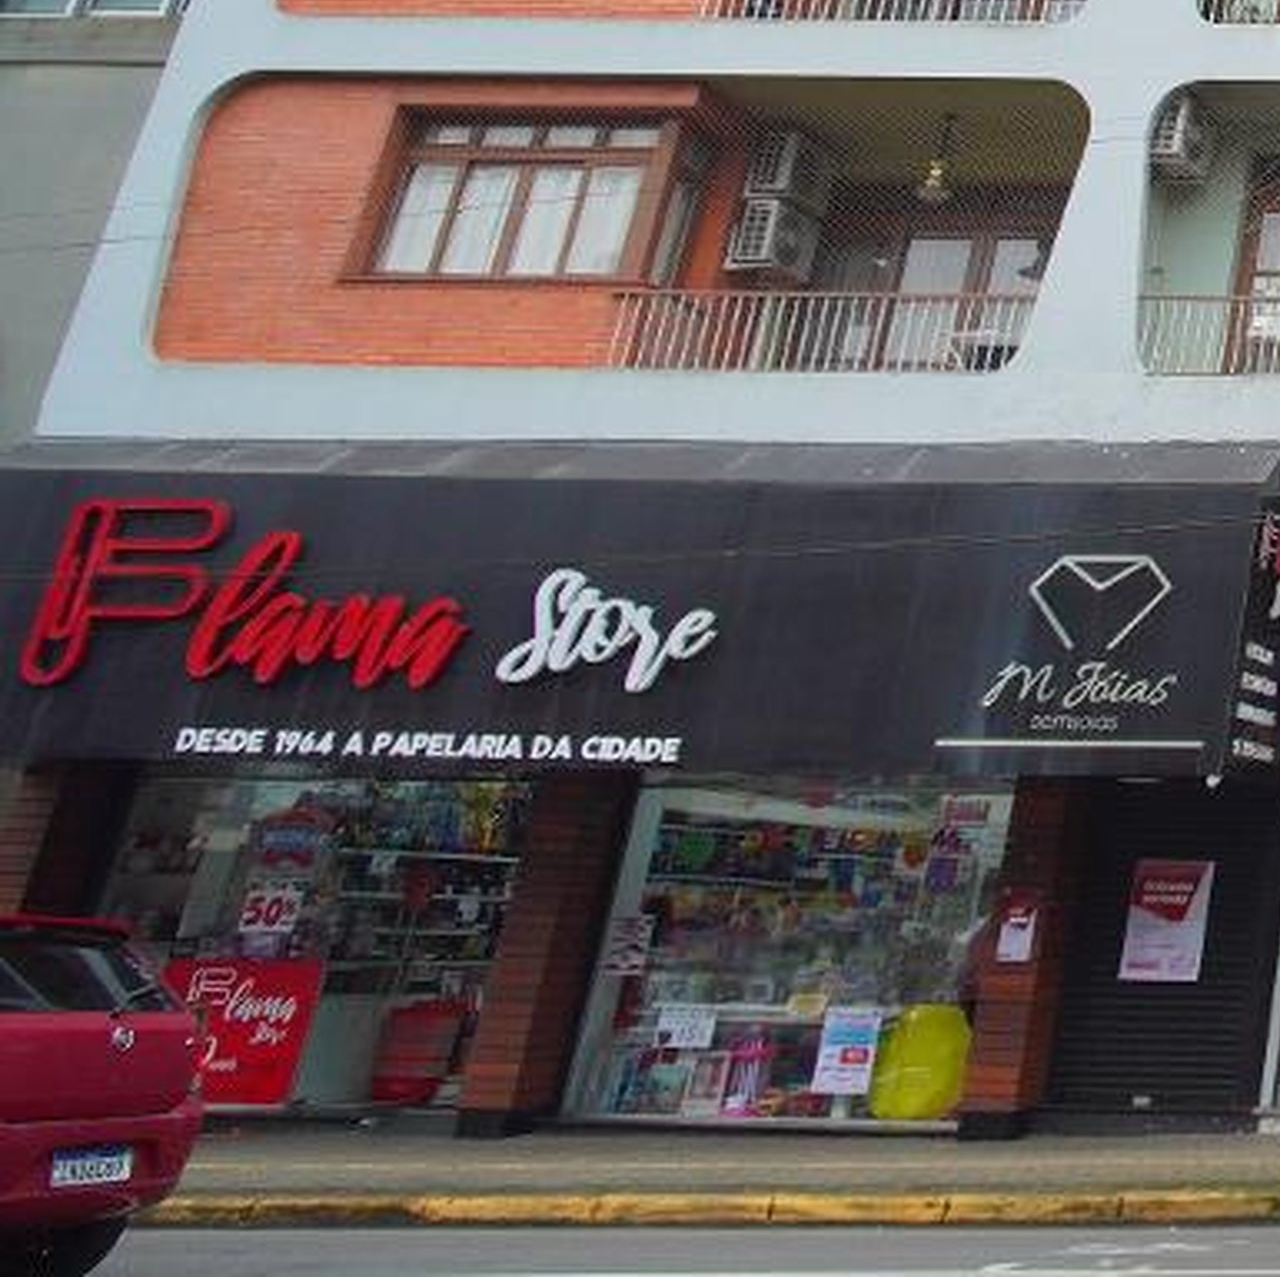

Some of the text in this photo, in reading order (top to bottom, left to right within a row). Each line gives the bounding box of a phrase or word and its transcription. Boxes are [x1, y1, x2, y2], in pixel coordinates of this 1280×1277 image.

[20, 498, 718, 692] Flama Store
[175, 727, 681, 763] DESDE 1964 A PAPELARIA DA CIDADE
